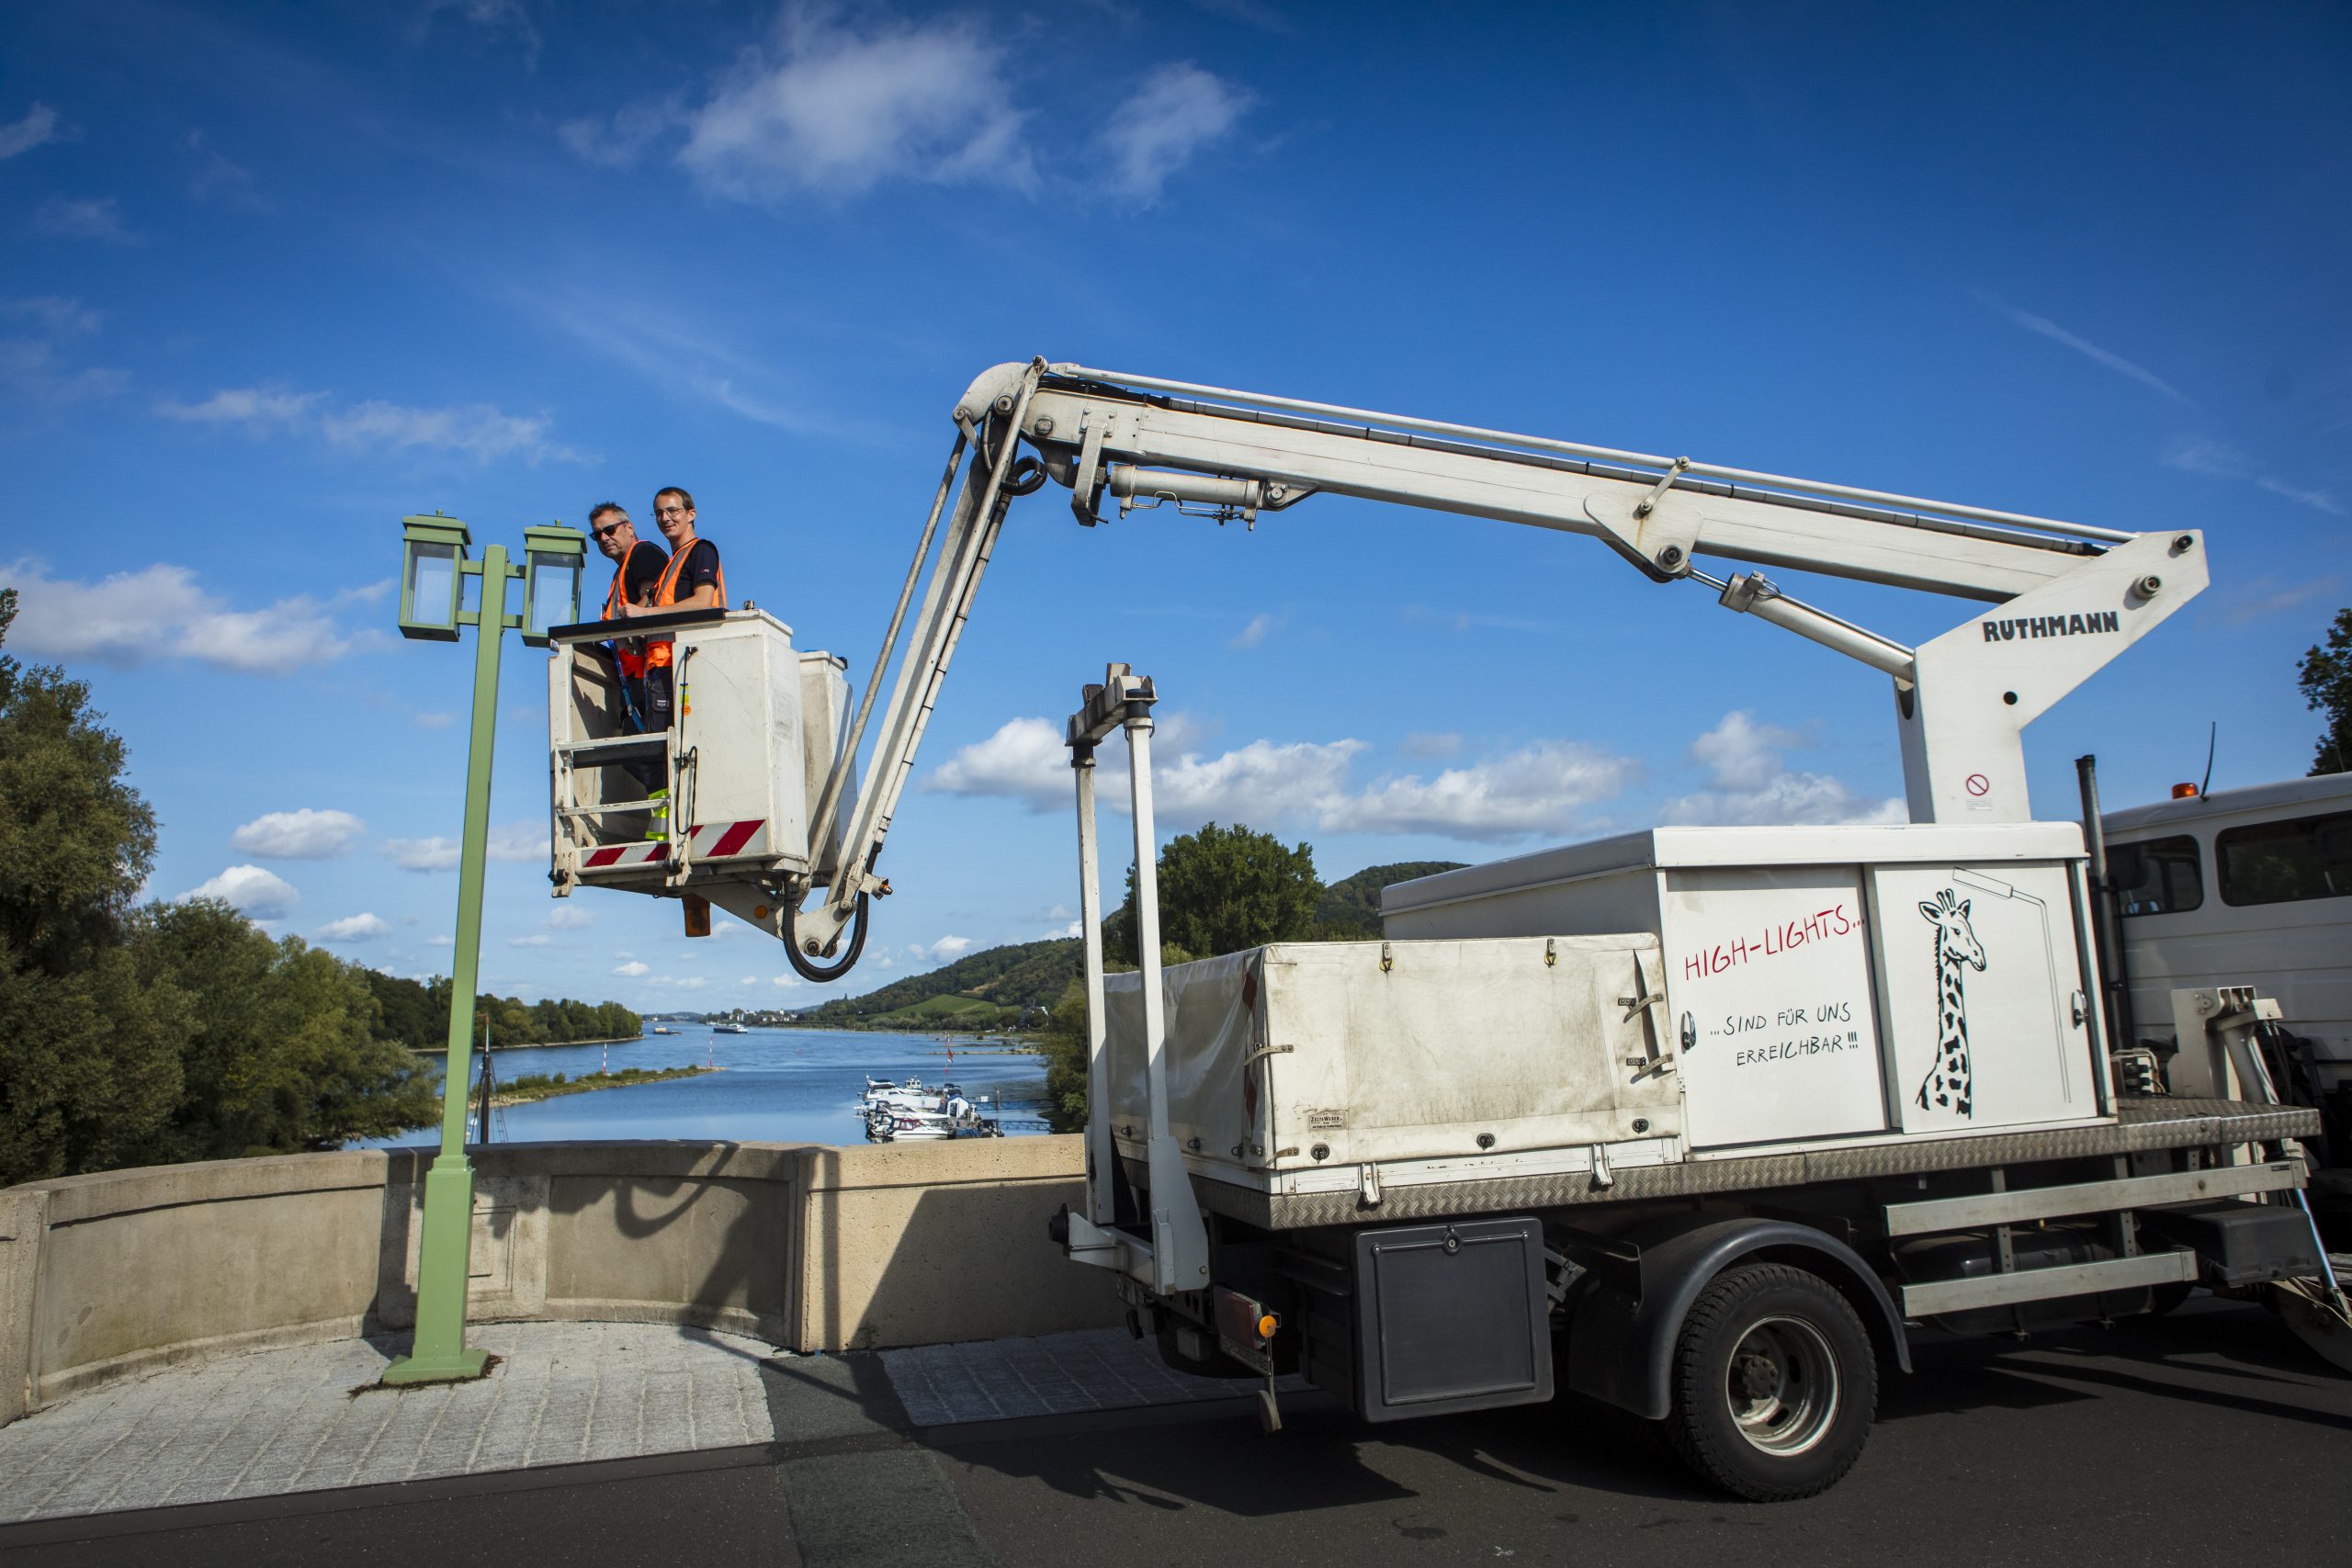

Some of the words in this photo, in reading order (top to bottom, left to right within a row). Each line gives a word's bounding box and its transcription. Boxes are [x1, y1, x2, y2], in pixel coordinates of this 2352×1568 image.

[1983, 611, 2120, 642] RUTHMANN
[1778, 1008, 1808, 1026] FÜR
[1816, 1001, 1850, 1022] UNS
